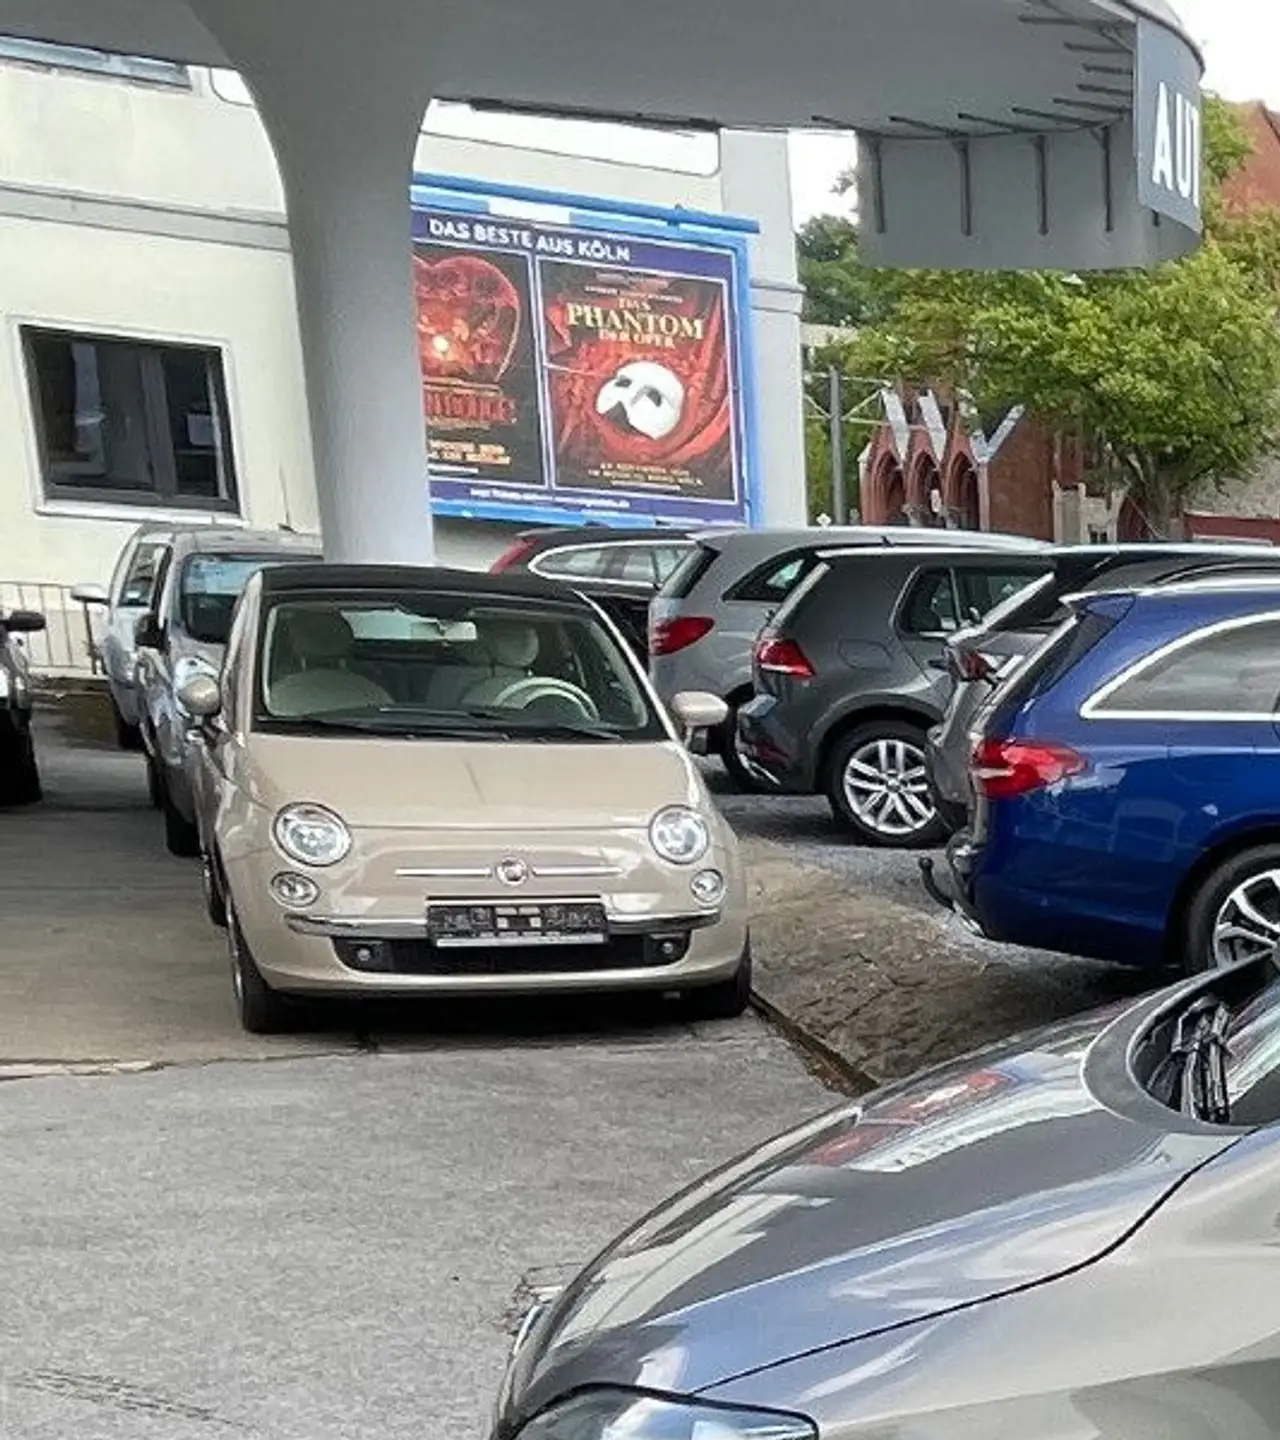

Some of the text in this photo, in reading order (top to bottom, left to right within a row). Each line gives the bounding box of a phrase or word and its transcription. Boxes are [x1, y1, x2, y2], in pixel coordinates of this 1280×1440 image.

[429, 218, 630, 261] DAS BESTE AUS KÖLN
[566, 301, 705, 340] PHANTOM
